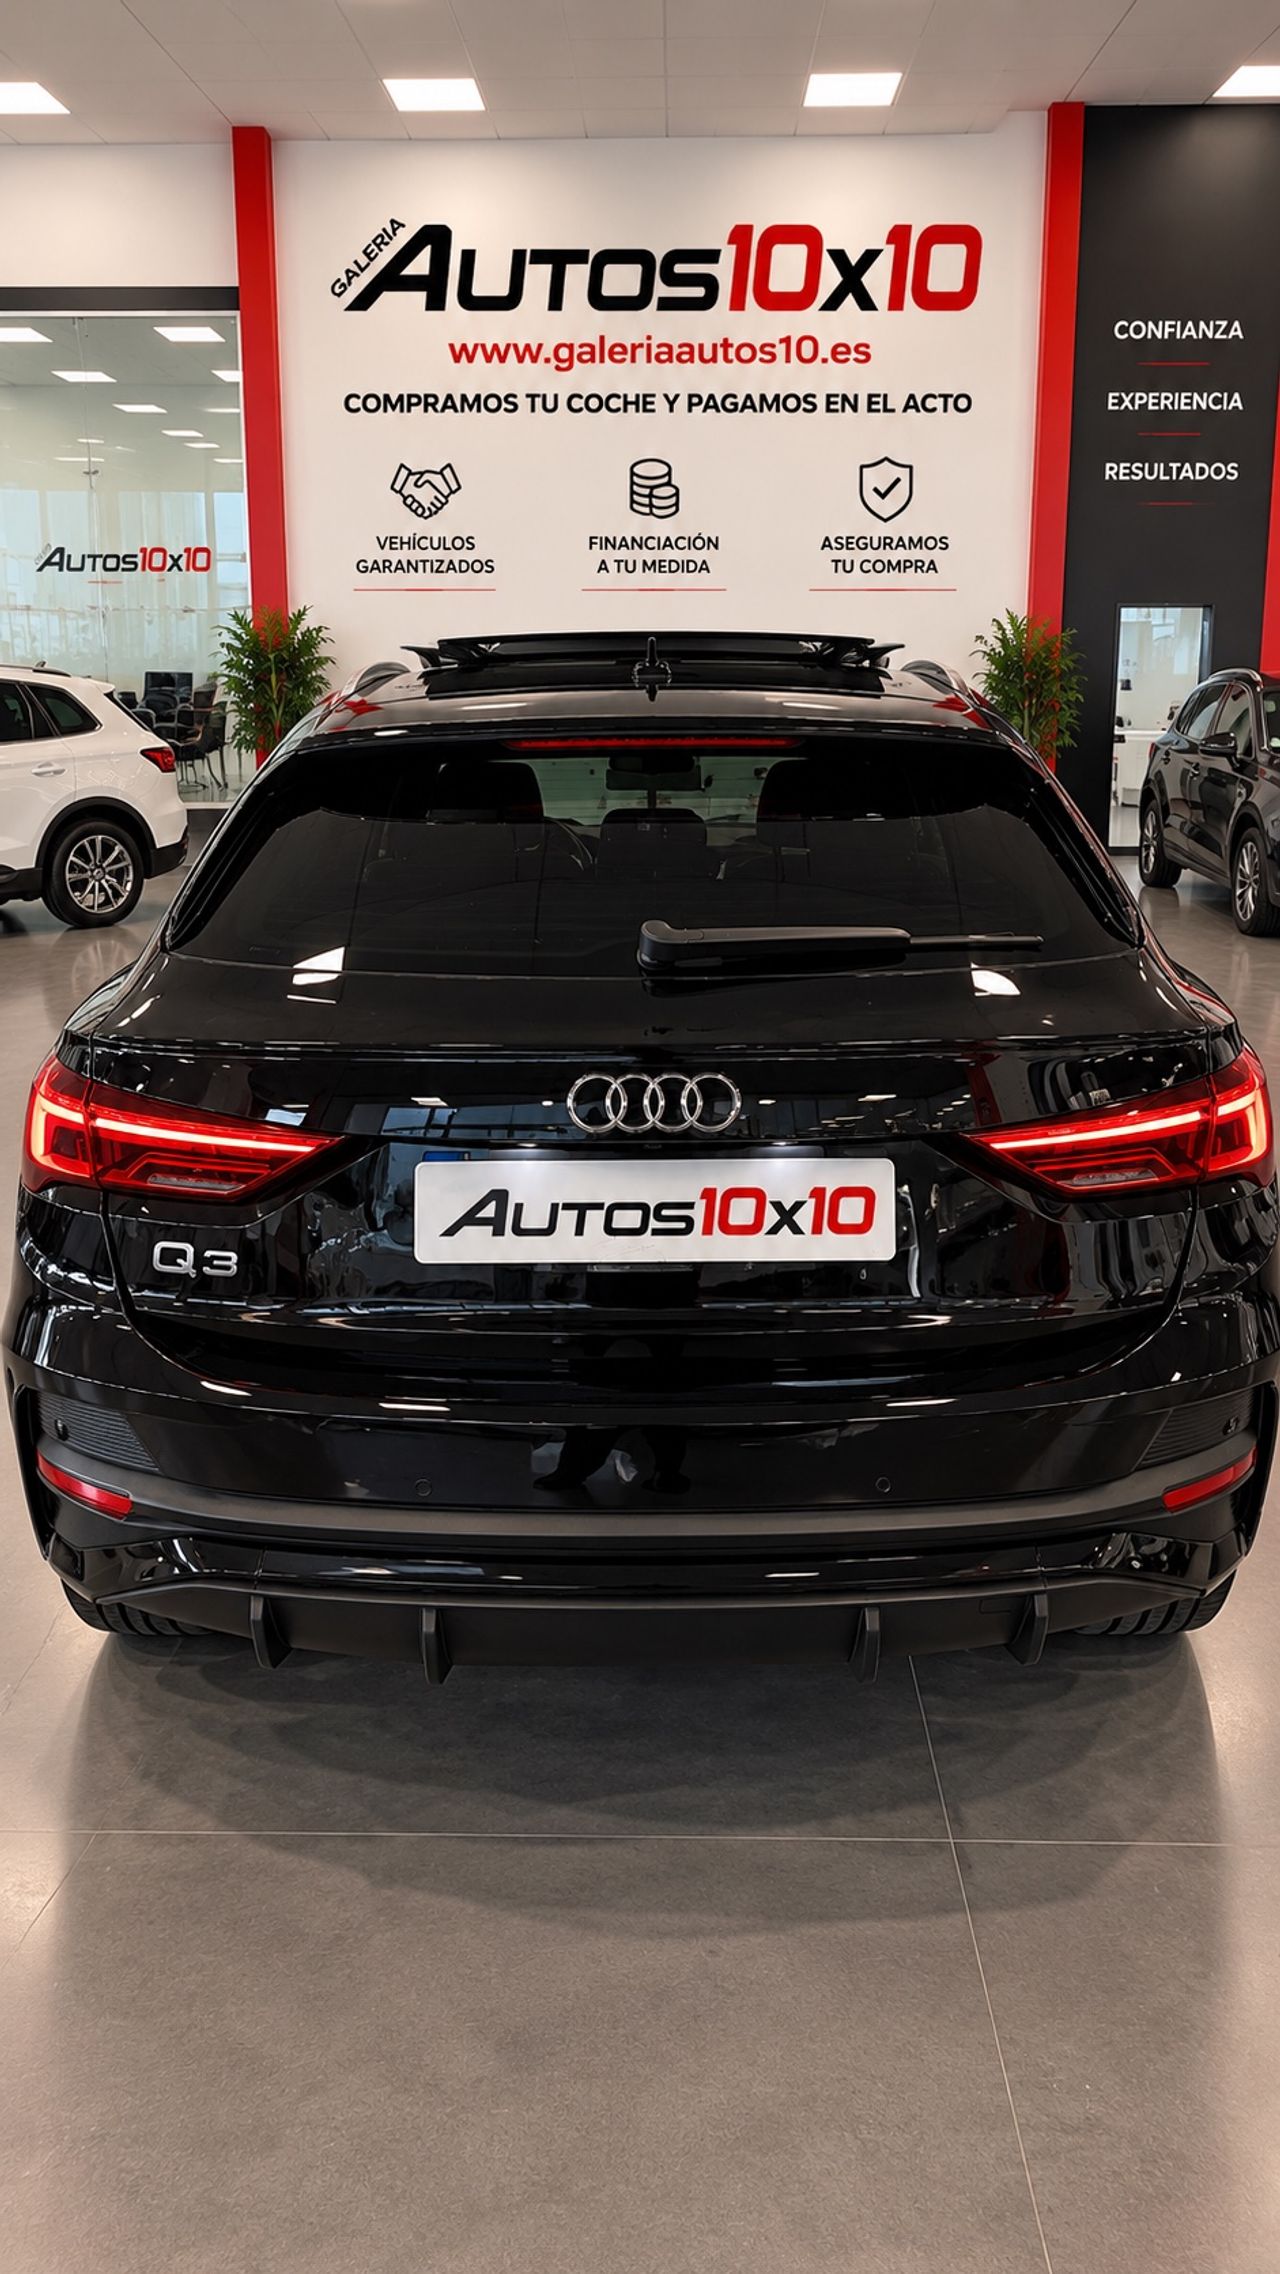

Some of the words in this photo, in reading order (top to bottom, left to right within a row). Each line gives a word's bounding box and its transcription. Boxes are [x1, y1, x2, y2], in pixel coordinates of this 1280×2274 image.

[330, 217, 407, 298] GALERIA
[1113, 320, 1244, 340] CONFIANZA
[448, 334, 872, 372] www.galeriaautos10.es
[343, 392, 519, 414] COMPRAMOS
[525, 393, 559, 414] TU
[566, 392, 657, 414] COCHE
[662, 393, 681, 414] Y
[687, 392, 818, 414] PAGAMOS
[825, 393, 859, 414] EN
[866, 393, 897, 414] EL
[902, 392, 973, 414] ACTO
[1107, 391, 1244, 411] EXPERIENCIA
[1104, 462, 1239, 481] RESULTADOS
[375, 532, 476, 551] VEHÍCULOS
[588, 532, 719, 551] FINANCIACIÓN
[820, 535, 950, 551] ASEGURAMOS
[355, 558, 495, 574] GARANTIZADOS
[596, 558, 611, 574] A
[613, 558, 637, 574] TU
[641, 558, 711, 574] MEDIDA
[830, 558, 855, 574] TU
[859, 558, 939, 574] COMPRA
